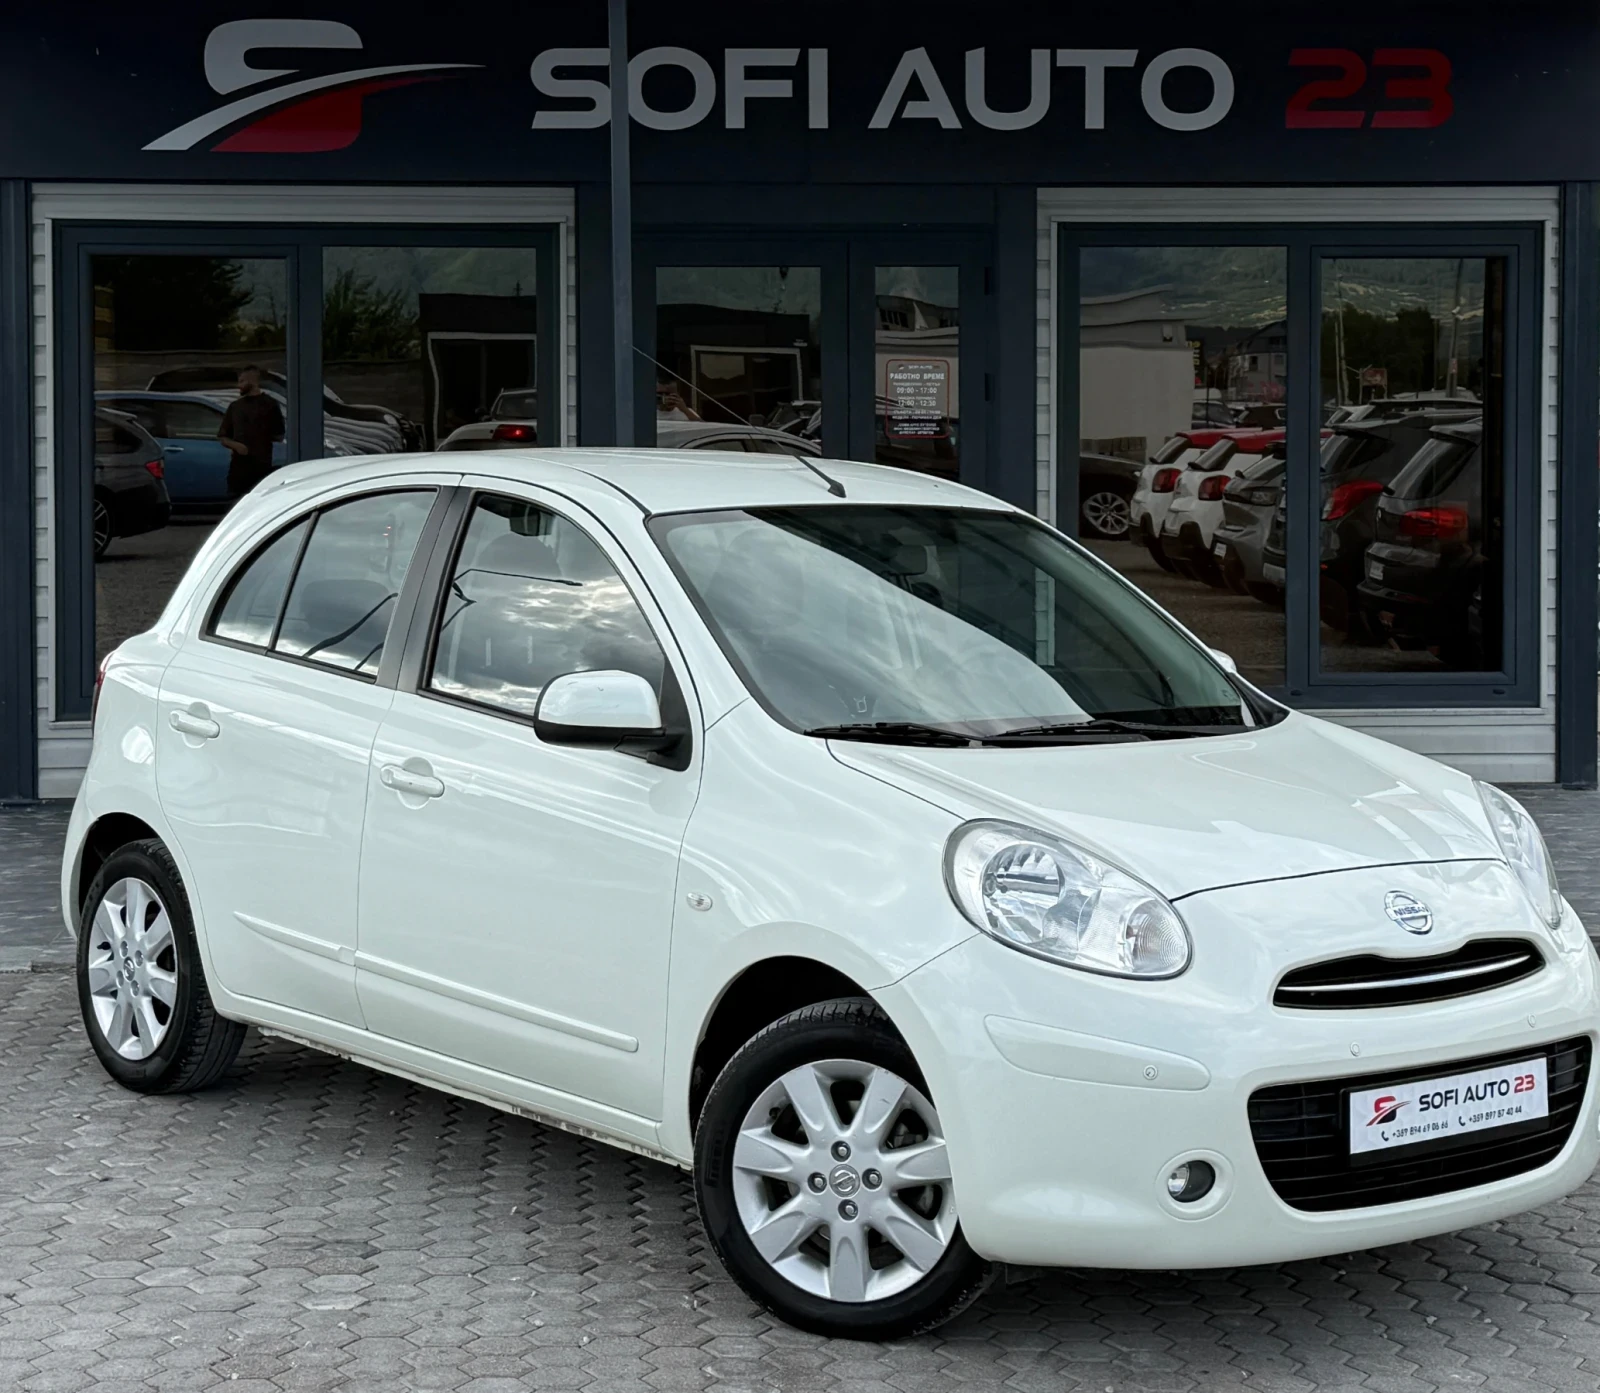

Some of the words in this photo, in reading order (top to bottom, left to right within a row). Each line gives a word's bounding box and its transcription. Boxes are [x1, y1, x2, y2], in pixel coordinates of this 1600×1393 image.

[530, 46, 829, 131] SOFI
[867, 46, 1235, 131] AUTO
[1285, 48, 1454, 129] 23
[1419, 1088, 1459, 1112] SOFI
[1463, 1078, 1510, 1103] AUTO
[1514, 1074, 1536, 1094] 23
